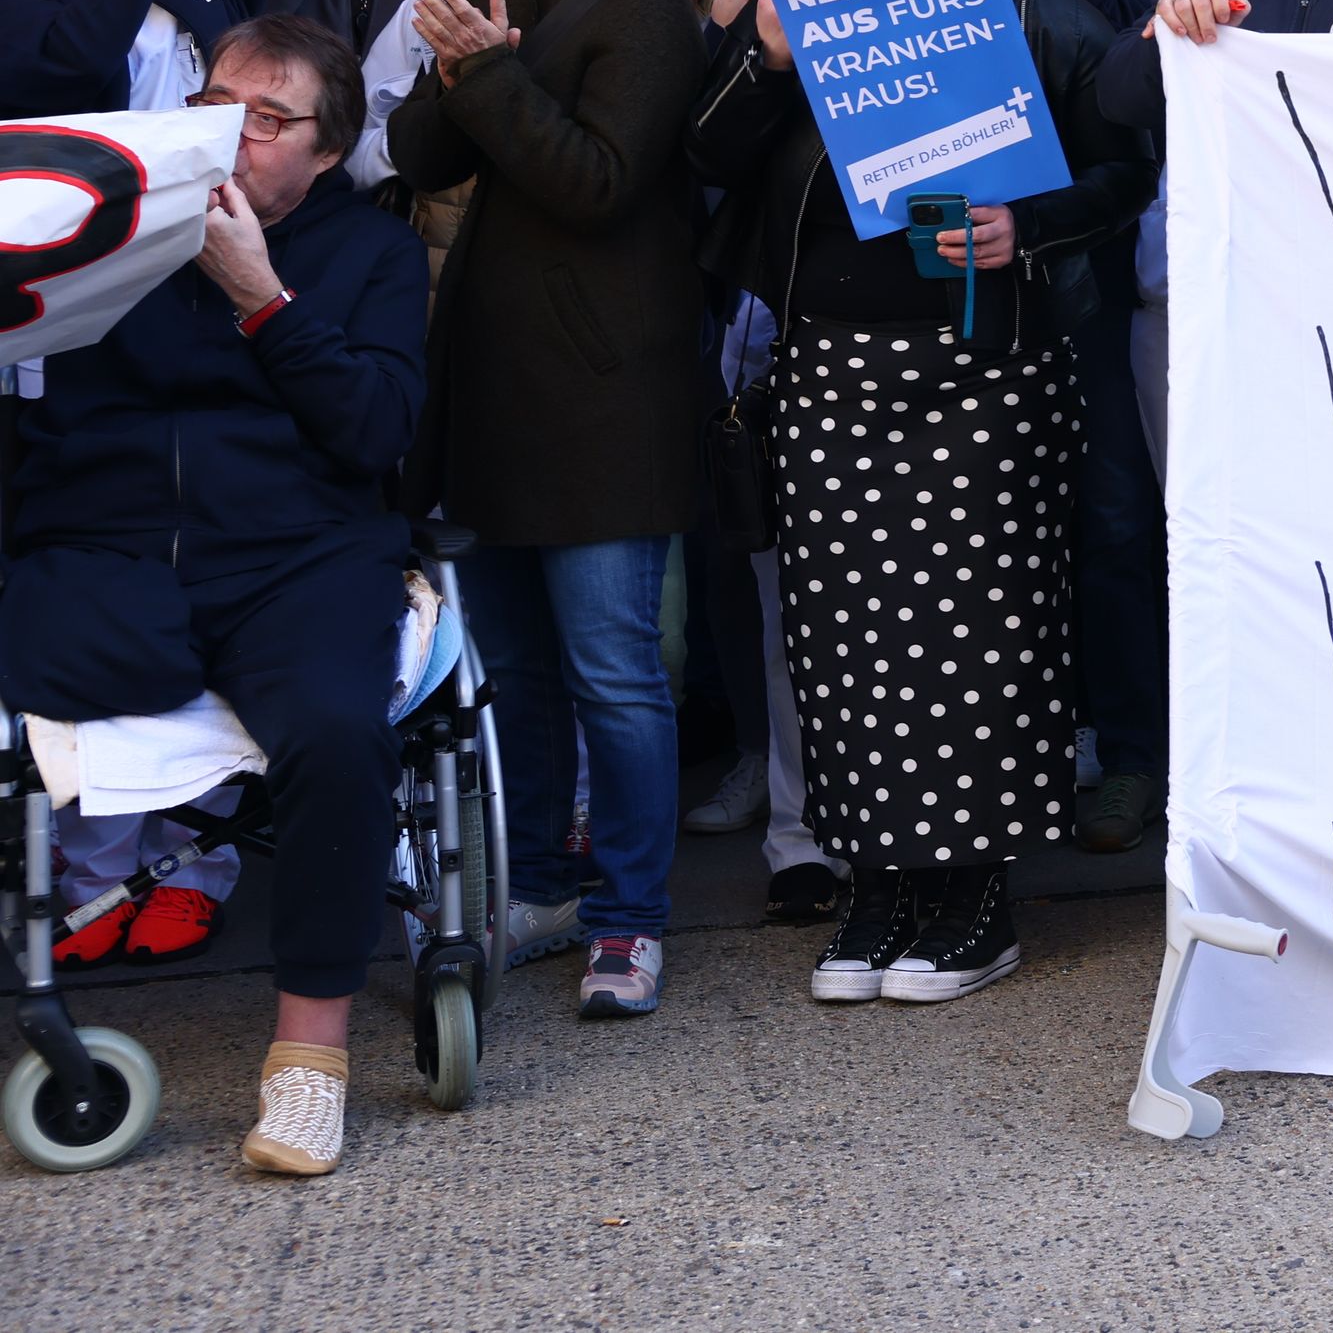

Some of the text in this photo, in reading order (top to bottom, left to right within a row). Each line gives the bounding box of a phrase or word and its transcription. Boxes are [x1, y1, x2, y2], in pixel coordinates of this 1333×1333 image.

[802, 8, 879, 48] AUS
[811, 17, 1005, 84] KRANKEN-
[824, 71, 939, 120] HAUS!
[862, 116, 1015, 186] RETTET DAS BÖHLER!
